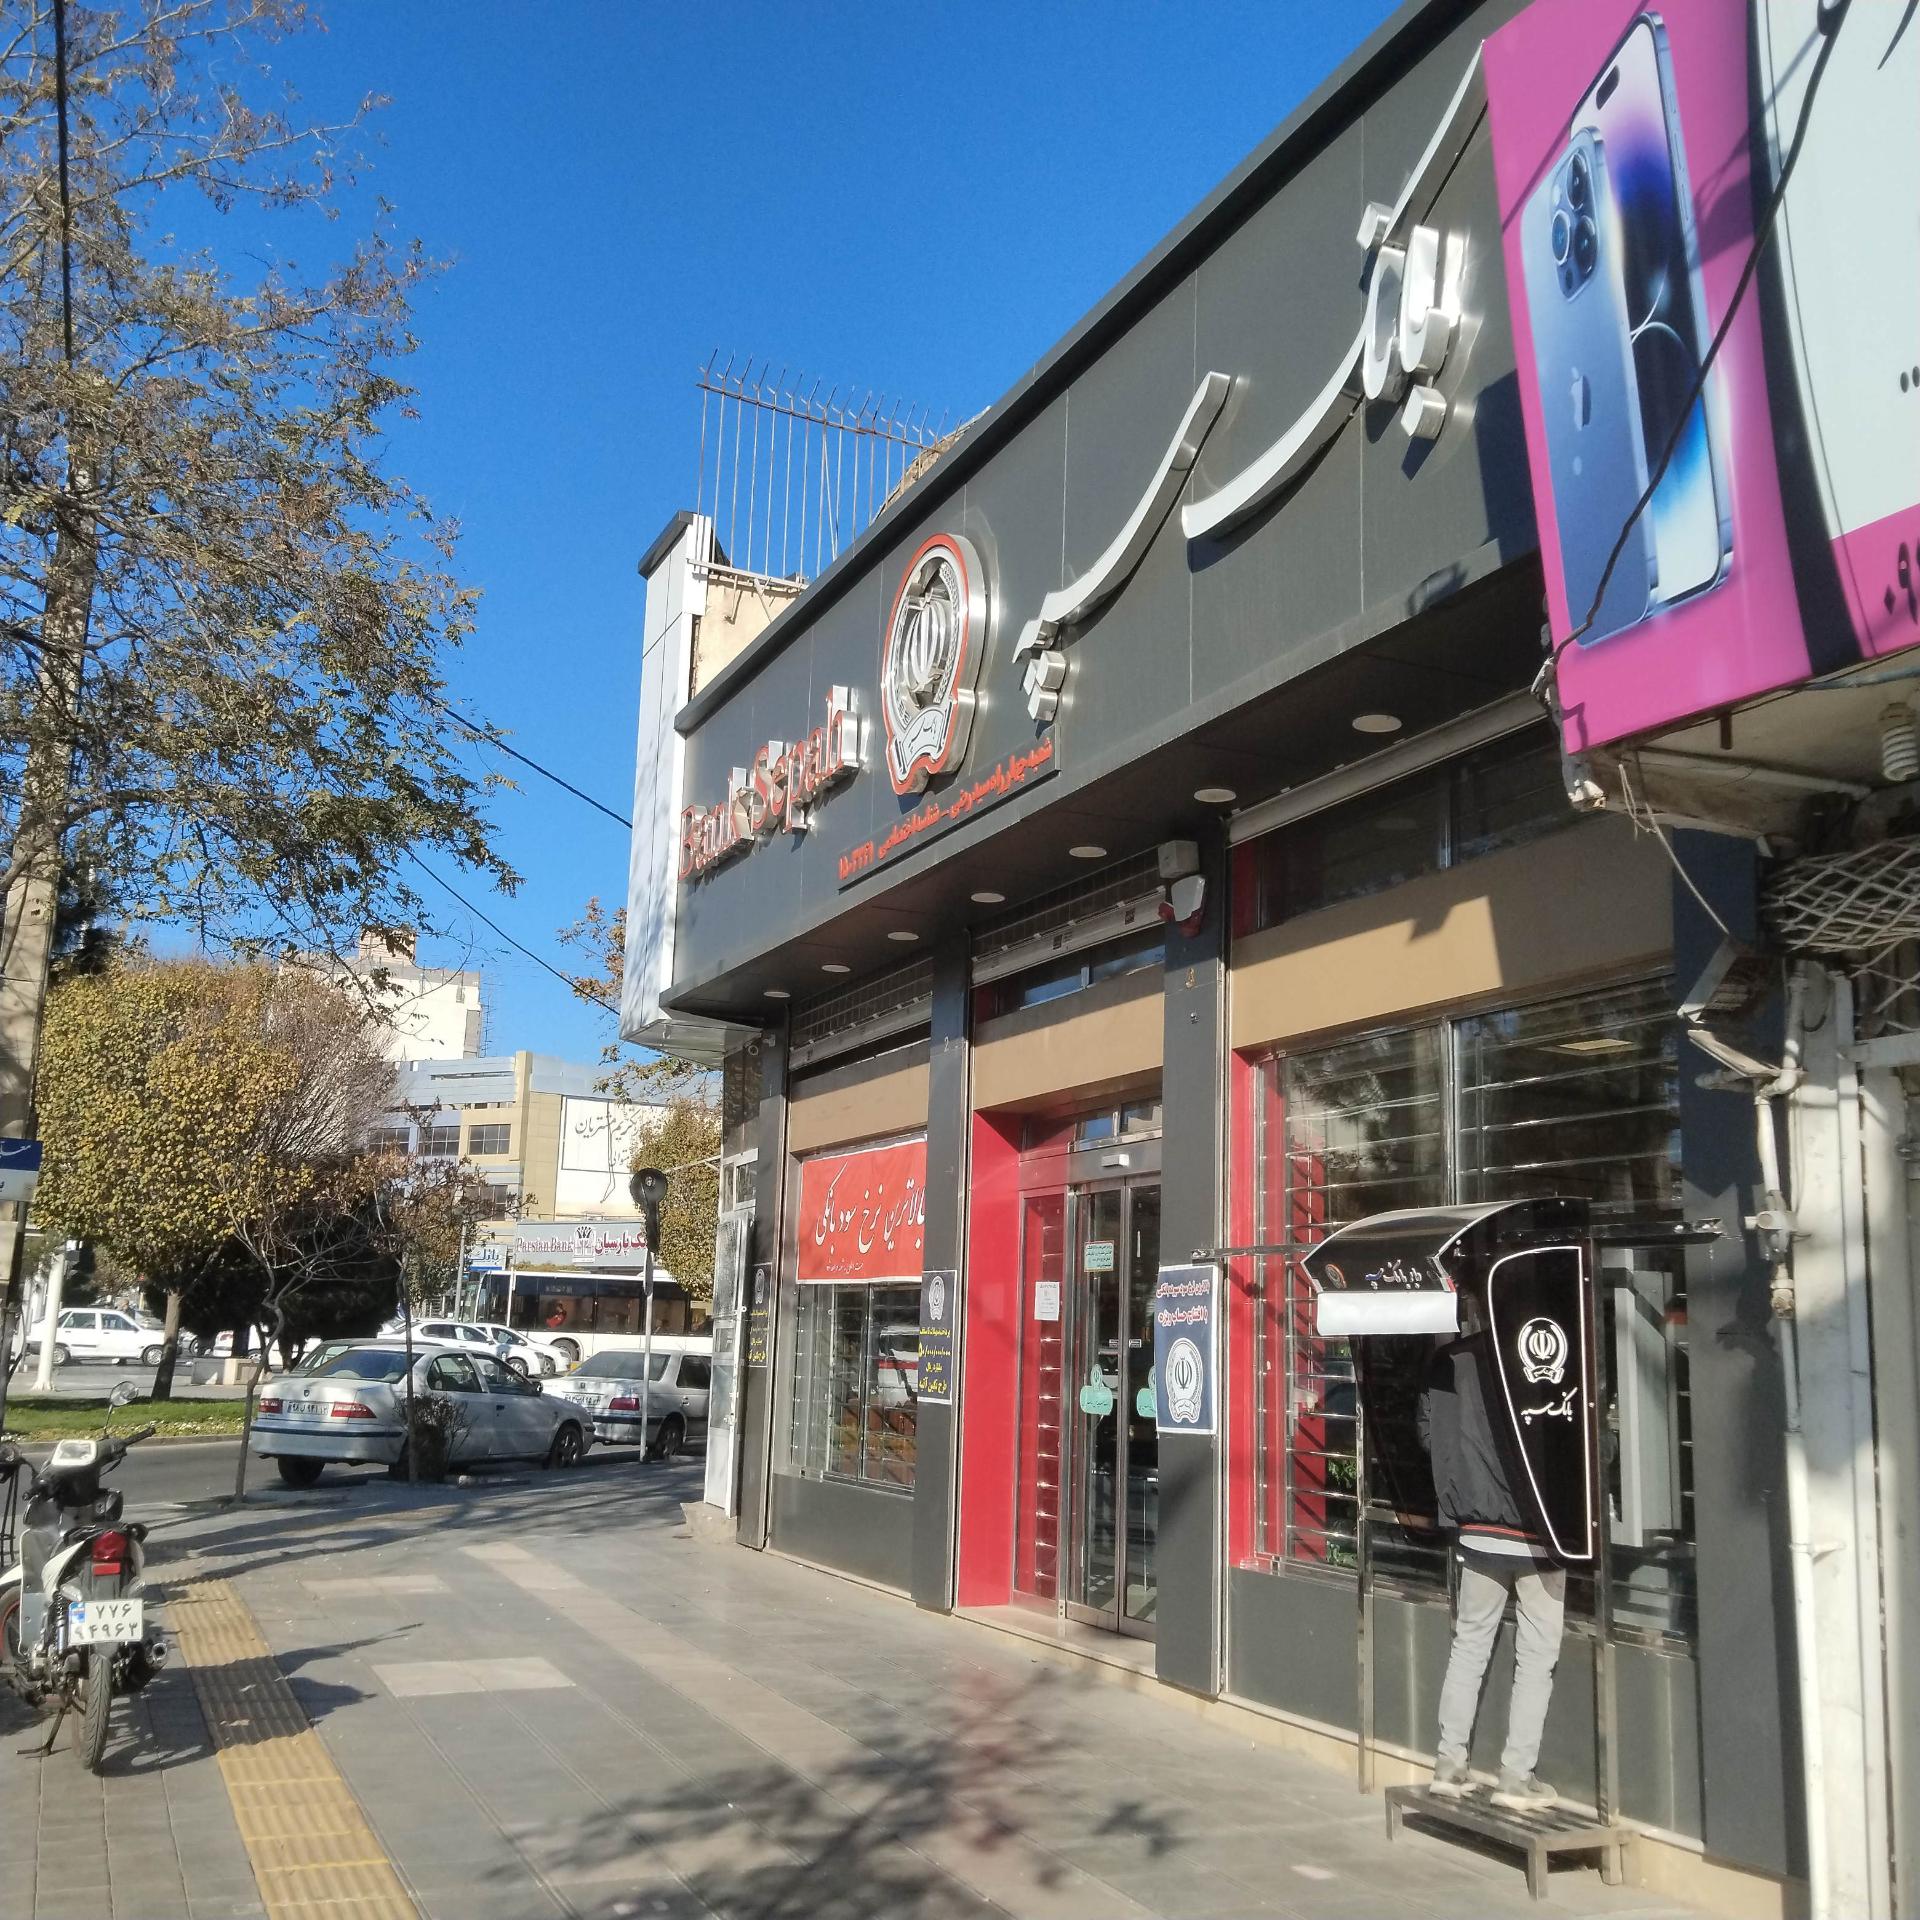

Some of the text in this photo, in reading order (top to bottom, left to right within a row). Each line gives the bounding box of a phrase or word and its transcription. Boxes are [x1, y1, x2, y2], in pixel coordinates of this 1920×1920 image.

[1011, 370, 1235, 722] سپه
[679, 767, 750, 880] Bank
[752, 685, 857, 834] Sepah
[575, 1114, 617, 1138] مشتریان
[838, 1205, 857, 1232] سود
[858, 1184, 882, 1254] نرخ
[882, 1178, 925, 1250] بالاترین
[517, 1237, 574, 1253] Parsian Bank
[594, 1231, 629, 1257] پارسیان
[1520, 1386, 1578, 1426] بانک سپه
[95, 1603, 132, 1619] ۷۷۶
